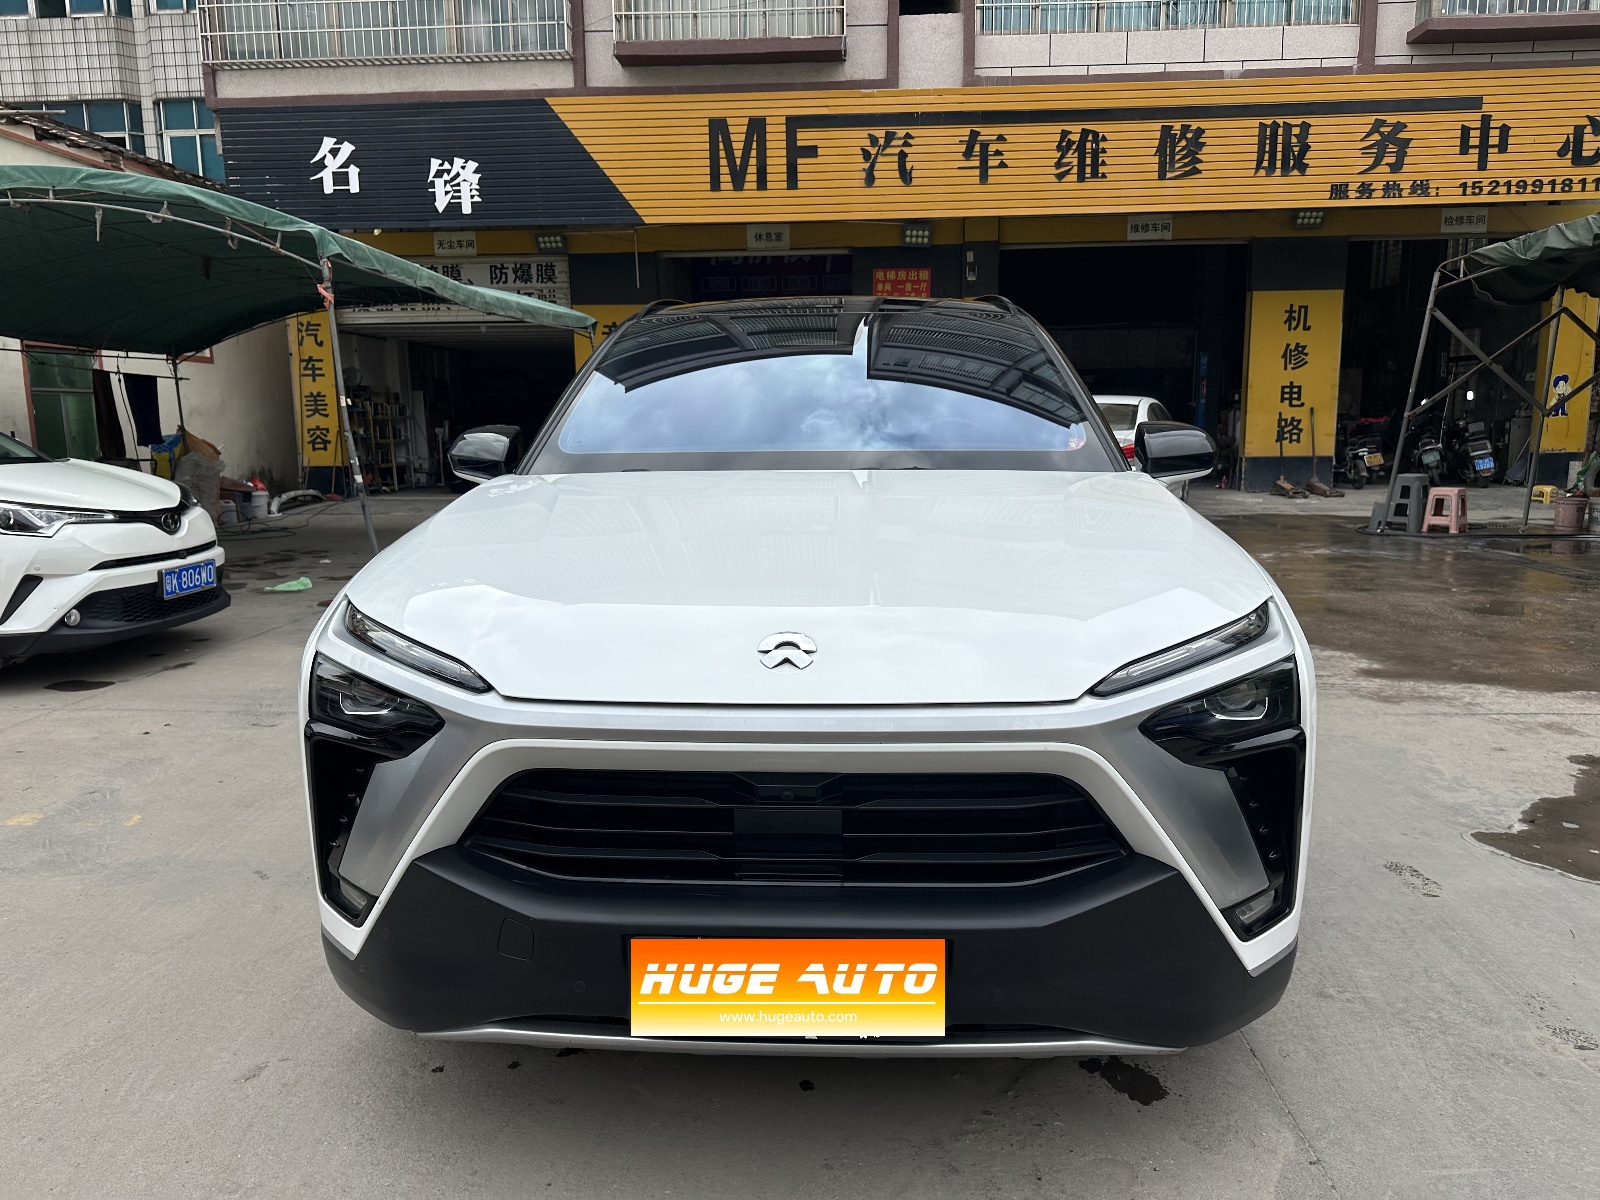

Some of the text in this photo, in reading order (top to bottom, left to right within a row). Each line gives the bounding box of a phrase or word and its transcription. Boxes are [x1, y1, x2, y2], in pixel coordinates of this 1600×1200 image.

[708, 114, 1600, 192] MF 汽车维修服务中心
[1443, 214, 1487, 227] 检修车间
[1129, 221, 1172, 235] 维修车间
[754, 231, 784, 243] 休息室
[436, 239, 475, 250] 无尘车间
[875, 270, 929, 281] 电梯房出租
[1276, 303, 1312, 445] 机修电路
[297, 321, 332, 452] 汽车美容
